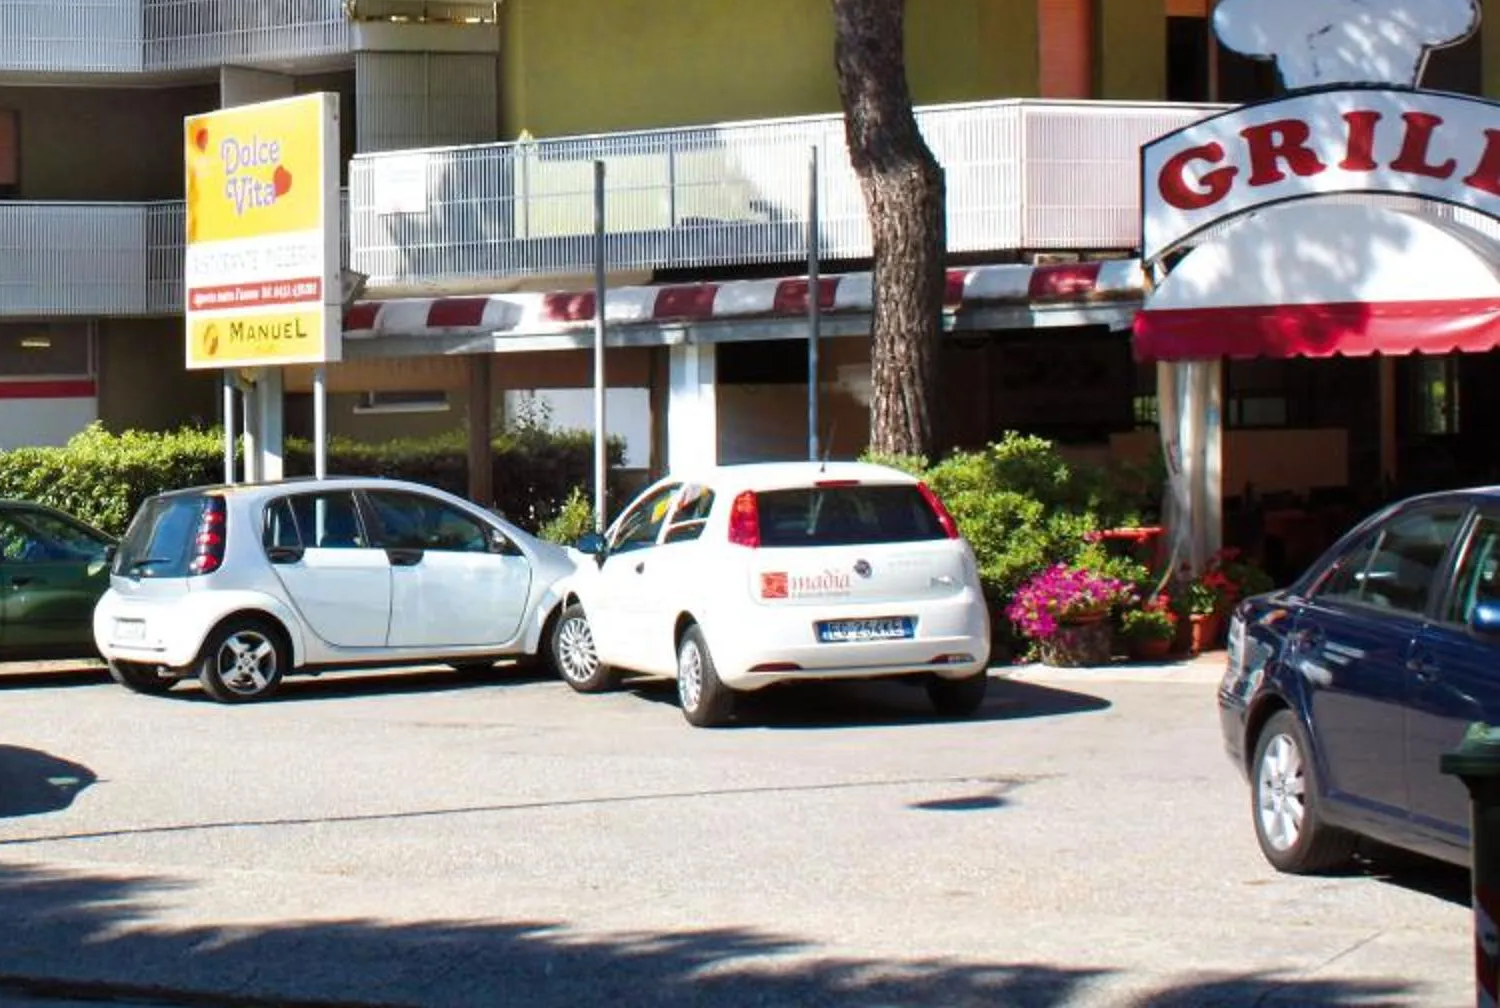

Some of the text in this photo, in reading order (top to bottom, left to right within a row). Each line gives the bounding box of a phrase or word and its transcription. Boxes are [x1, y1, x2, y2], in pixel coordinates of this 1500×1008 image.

[221, 135, 279, 175] Dolce
[226, 176, 276, 216] Vita
[229, 317, 307, 343] MANUEL
